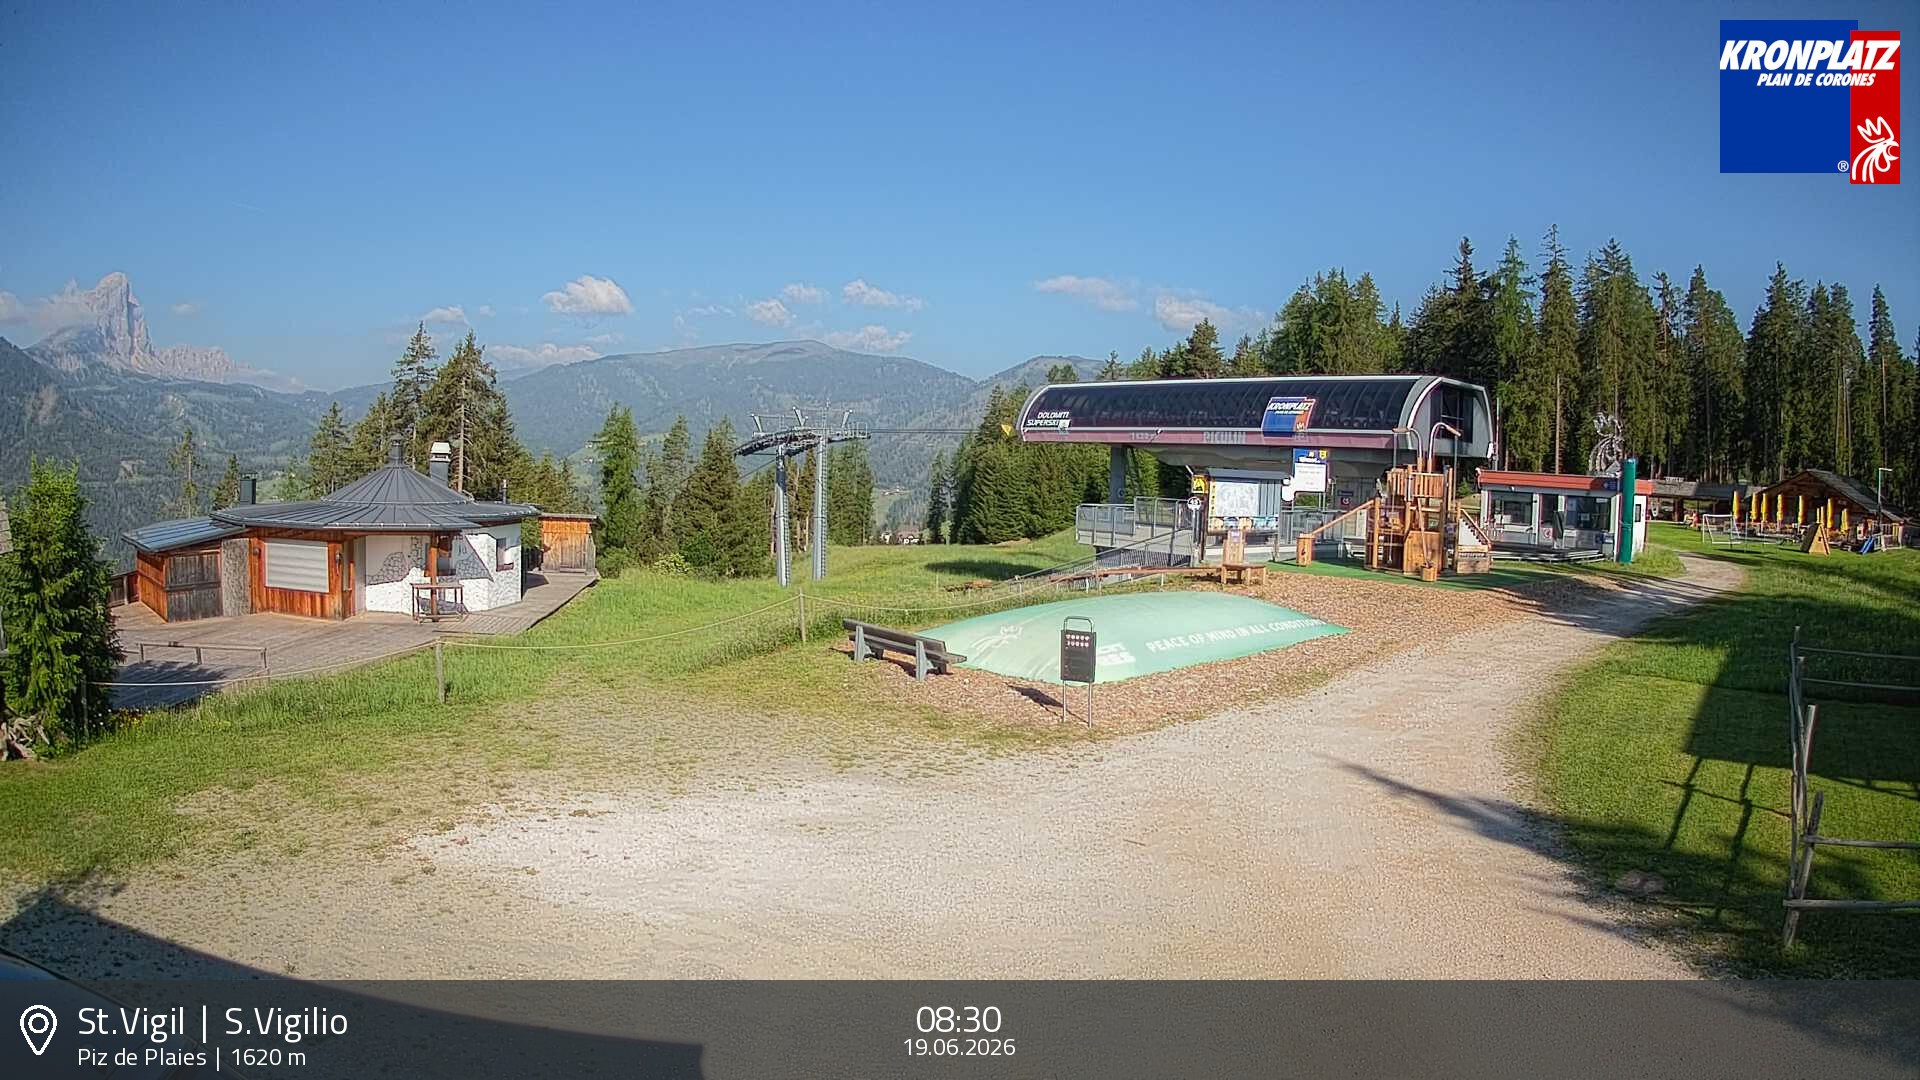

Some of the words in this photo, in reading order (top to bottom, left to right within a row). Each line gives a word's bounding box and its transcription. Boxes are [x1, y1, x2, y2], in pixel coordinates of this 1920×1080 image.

[1037, 411, 1070, 419] DOLOMITI
[1145, 635, 1190, 653] PEACE
[1190, 632, 1206, 645] OF
[1206, 628, 1235, 642] MIND
[1249, 623, 1271, 636] ALL
